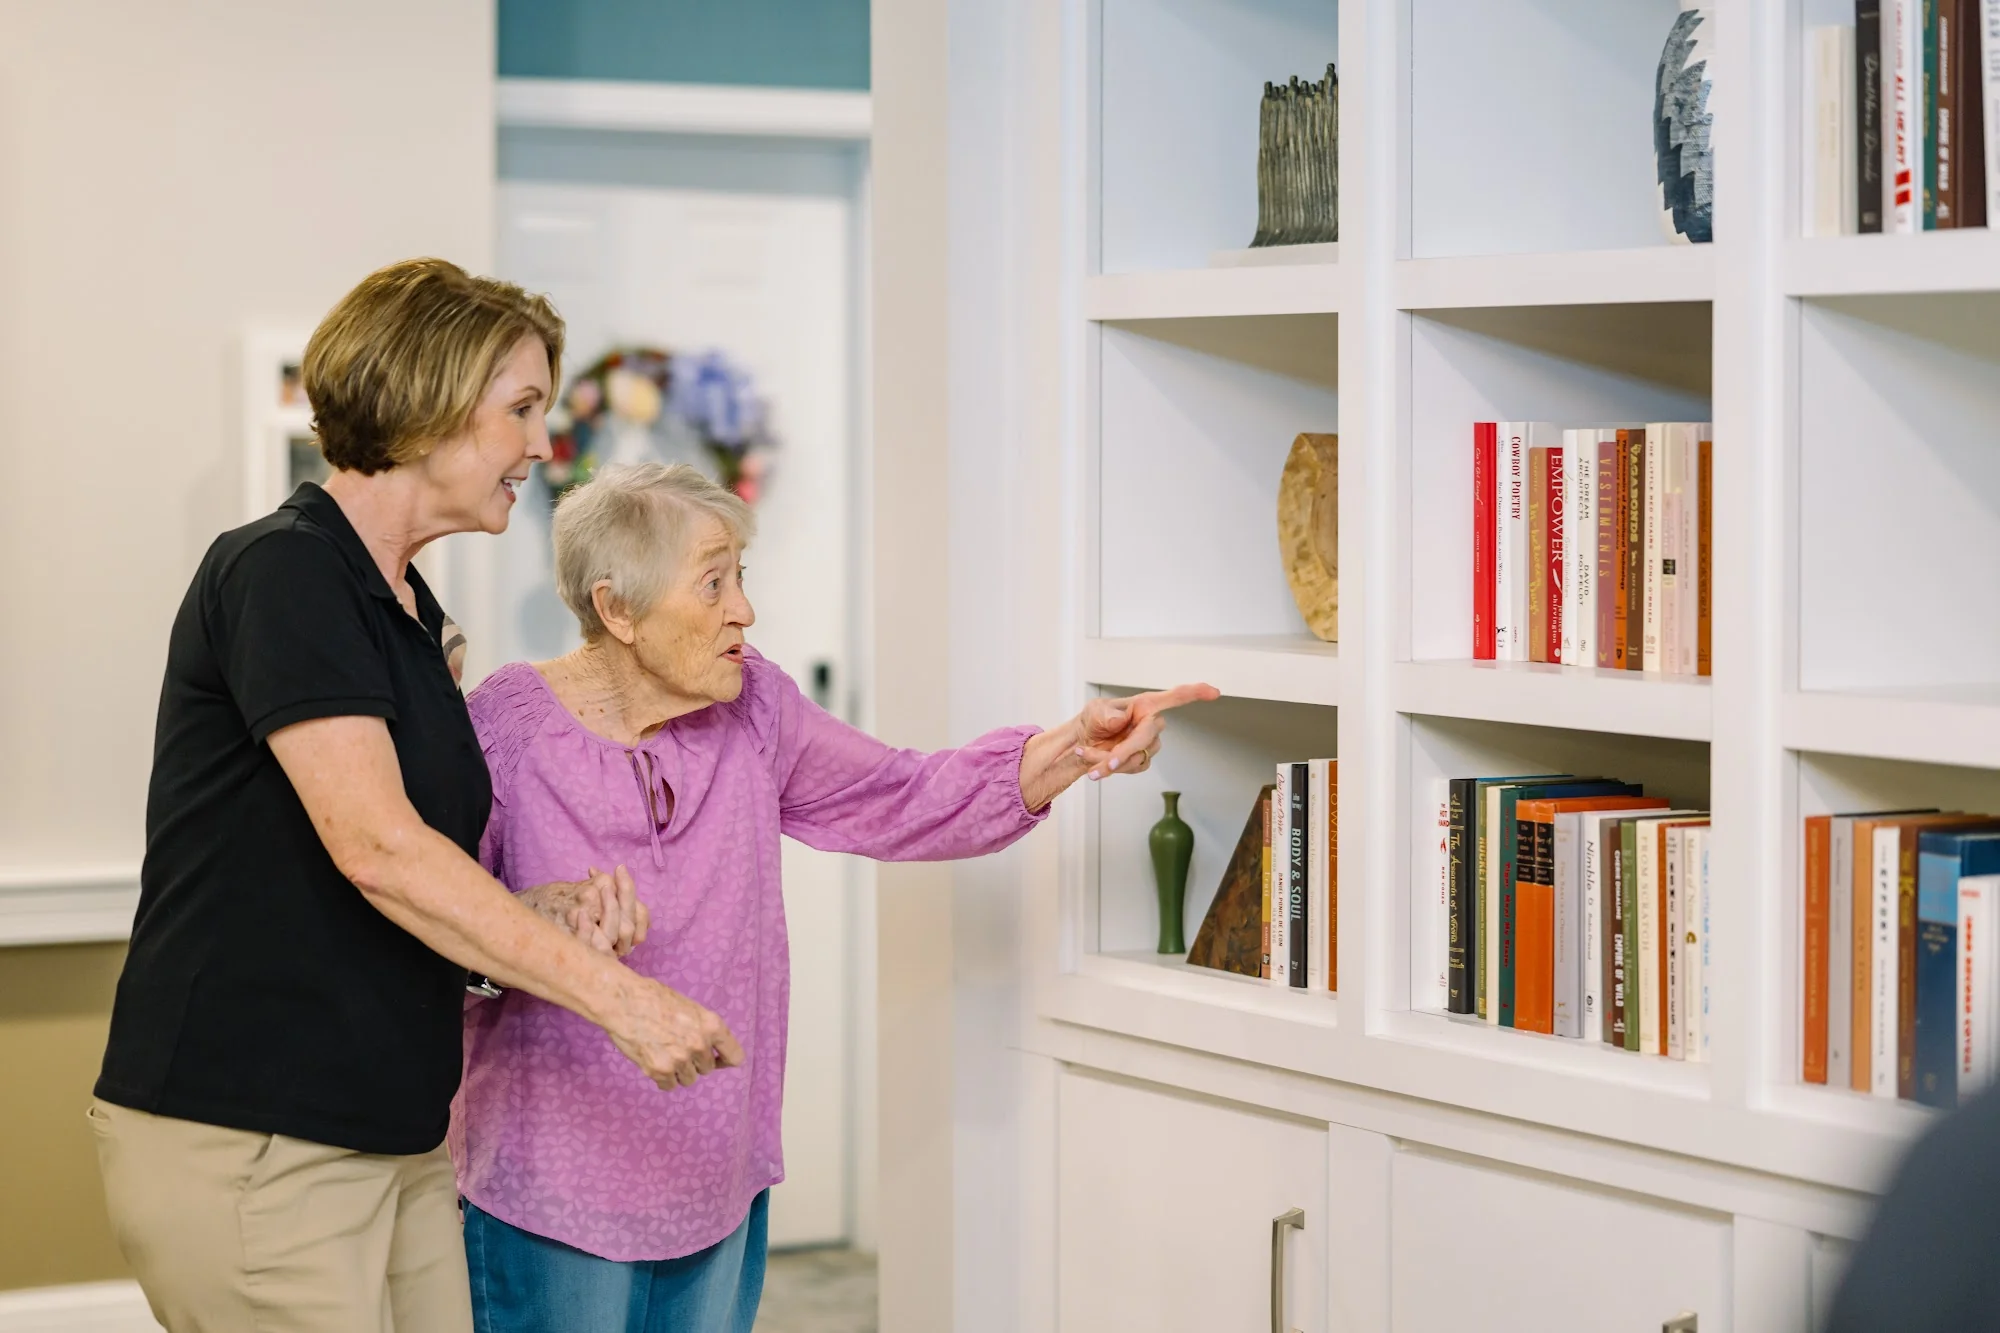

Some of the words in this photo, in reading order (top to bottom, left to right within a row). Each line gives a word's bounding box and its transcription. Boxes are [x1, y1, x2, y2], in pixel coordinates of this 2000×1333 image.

[1511, 436, 1521, 478] COWBOY
[1511, 480, 1521, 520] POETRY
[1551, 454, 1563, 563] EMPOWER
[1630, 445, 1640, 543] VAGABONDS
[1292, 827, 1302, 867] BODY
[1450, 832, 1461, 850] The
[1292, 869, 1300, 881] &
[1450, 855, 1462, 897] Assassin
[1586, 840, 1595, 891] Nimble
[1291, 885, 1301, 921] SOUL
[1449, 899, 1458, 911] of
[1641, 883, 1649, 951] SCRATCH
[1614, 934, 1624, 967] EMPIRE
[1615, 968, 1624, 981] OF
[1615, 982, 1625, 1008] WILD
